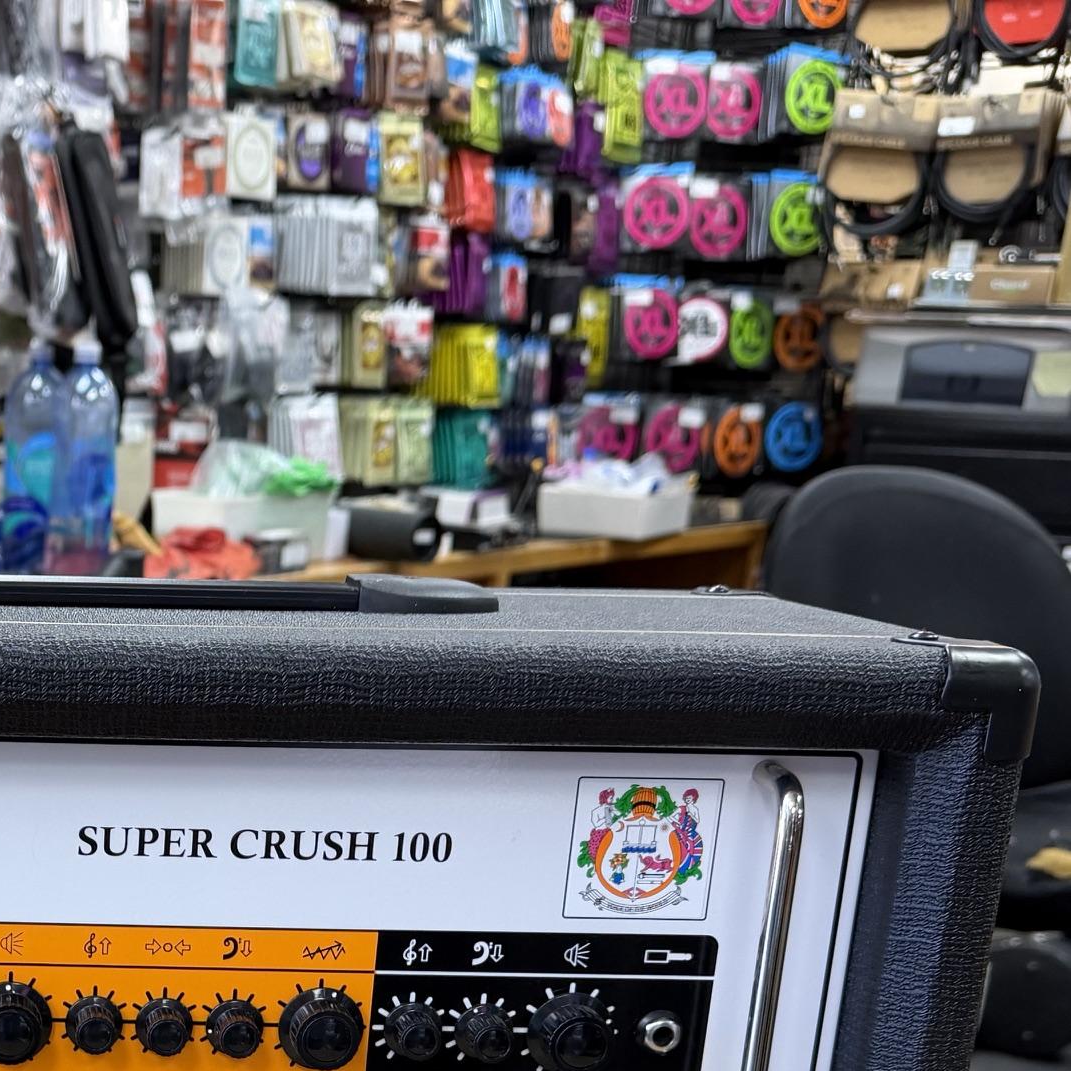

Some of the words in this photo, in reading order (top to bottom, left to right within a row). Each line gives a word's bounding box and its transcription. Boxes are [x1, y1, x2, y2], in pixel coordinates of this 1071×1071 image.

[78, 825, 217, 858] SUPER
[230, 829, 379, 861] CRUSH
[393, 832, 453, 863] 100
